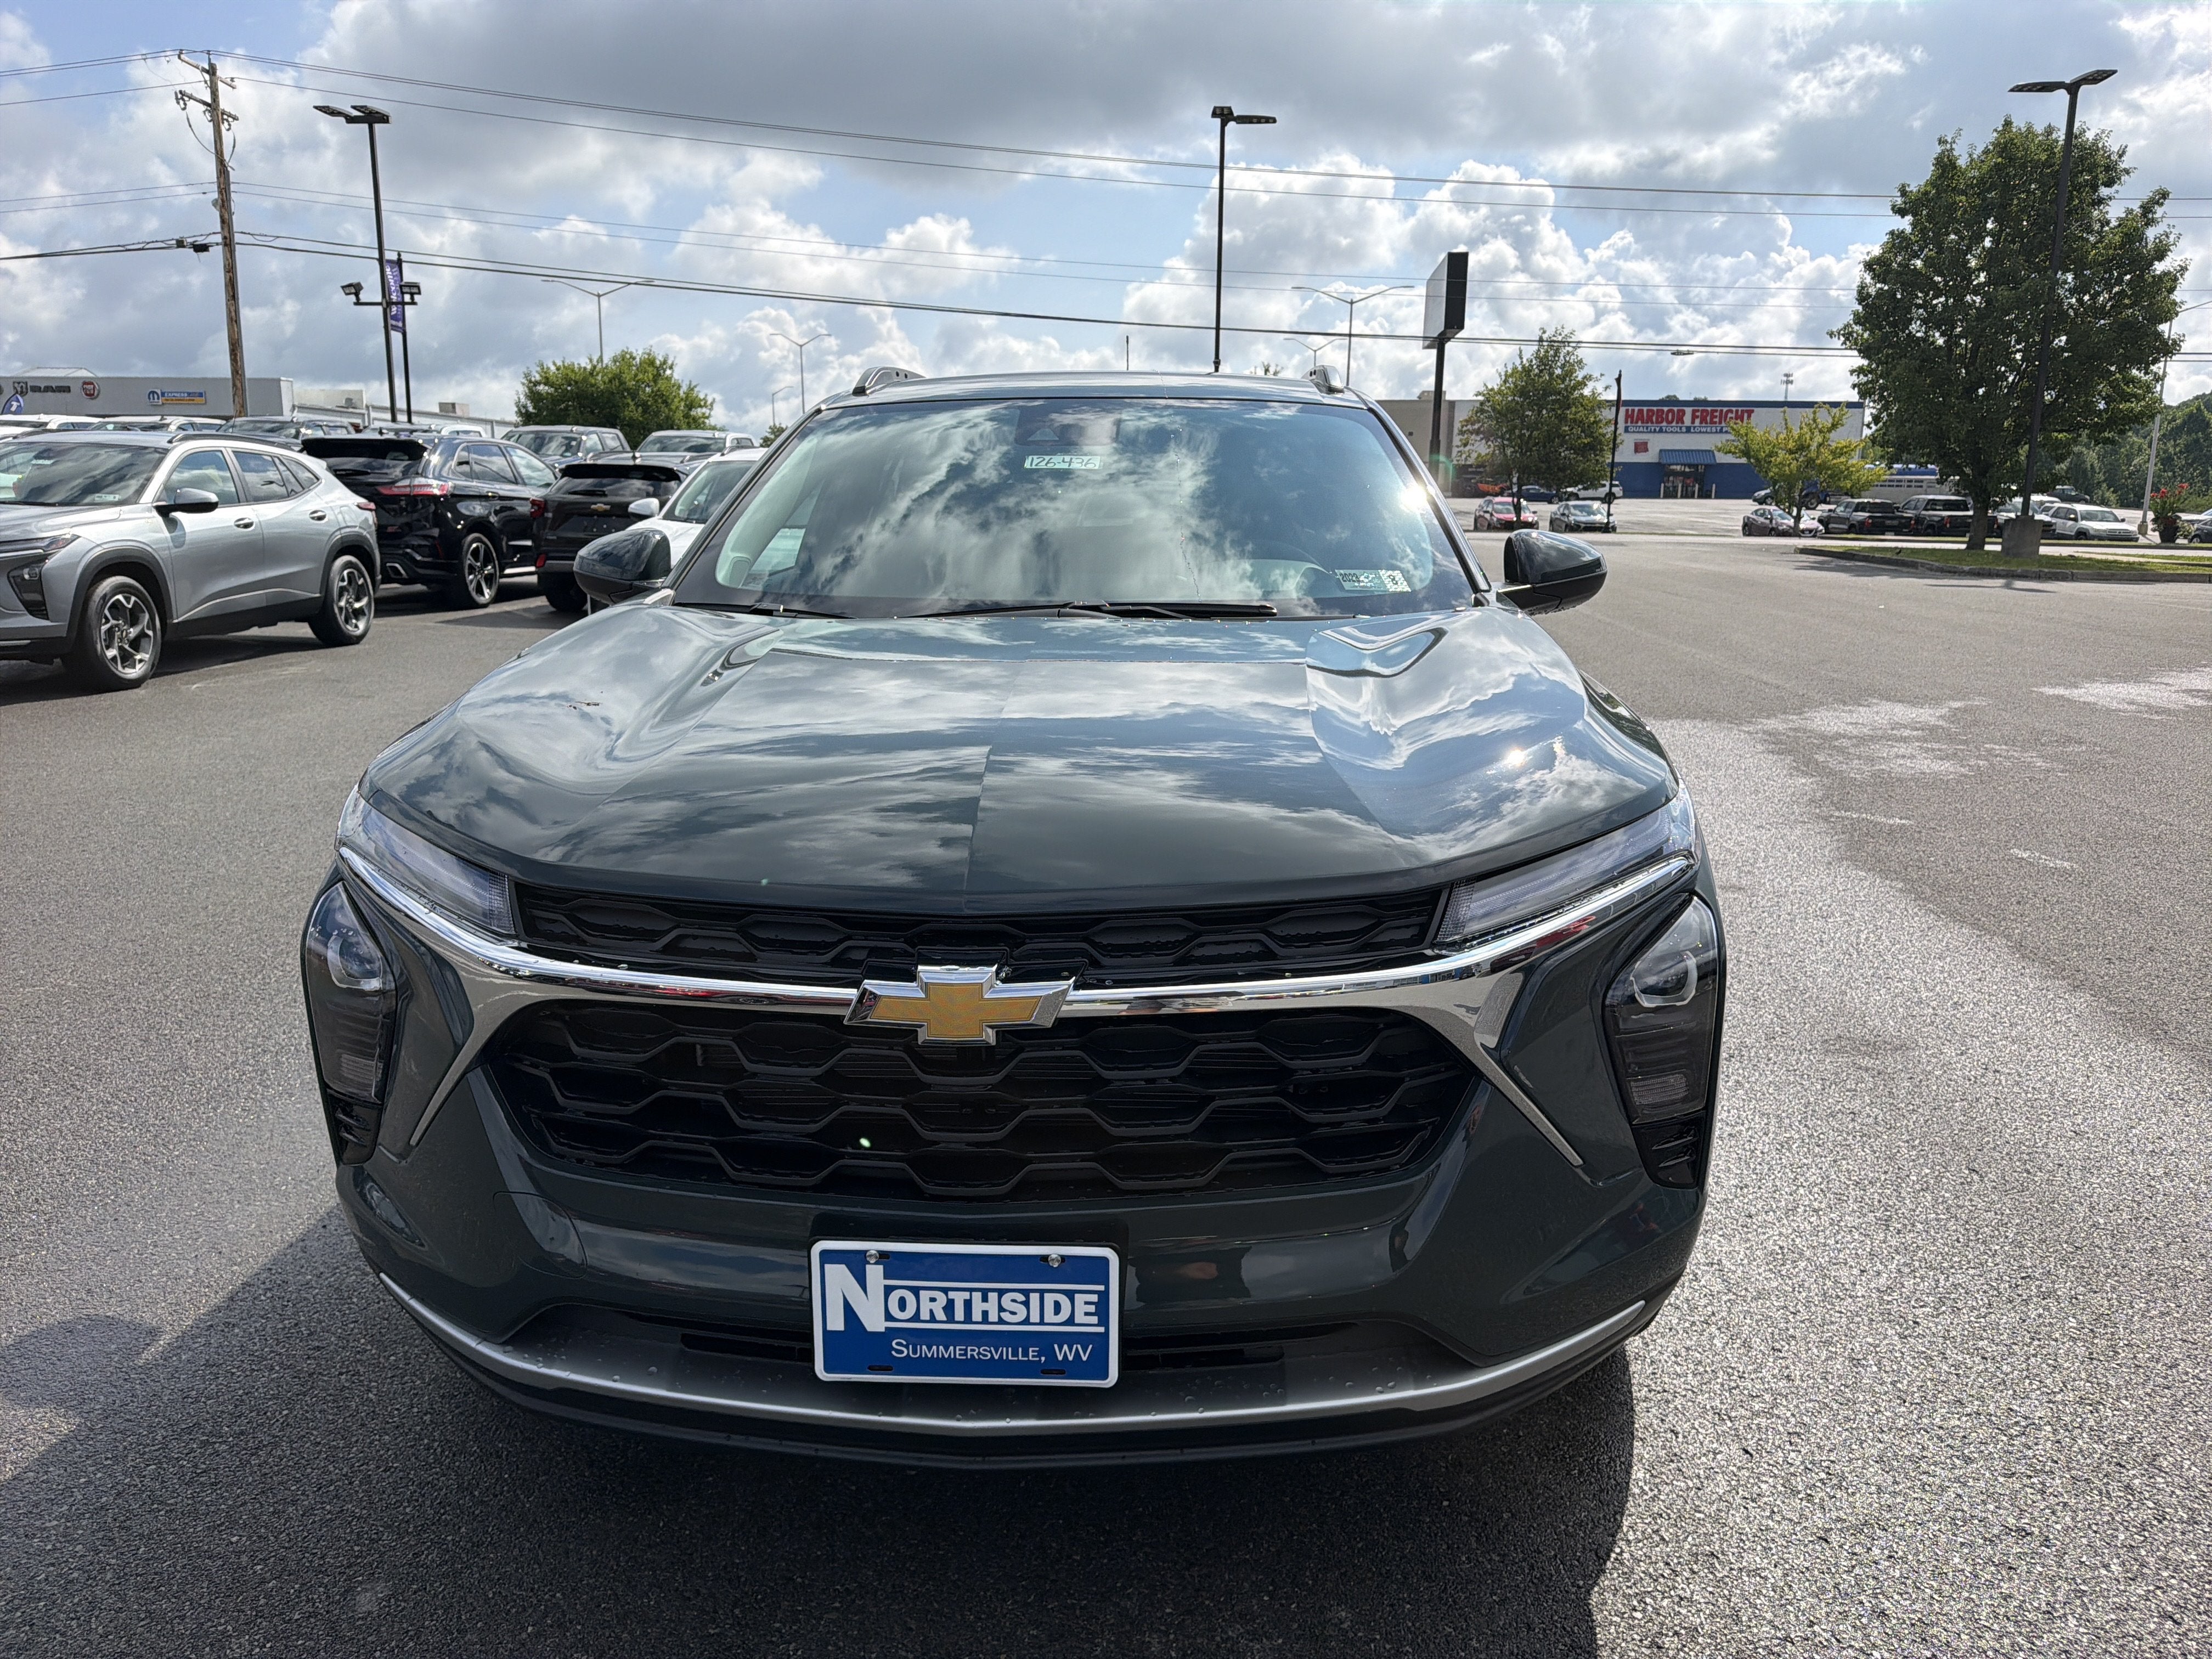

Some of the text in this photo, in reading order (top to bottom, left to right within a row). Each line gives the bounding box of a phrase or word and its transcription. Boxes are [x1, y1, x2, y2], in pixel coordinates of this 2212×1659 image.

[385, 264, 397, 315] Wlcome
[1624, 408, 1754, 425] HARBOR FREIGHT
[1029, 456, 1097, 468] 126-436
[824, 1263, 1099, 1332] NORTHSIDE
[891, 1339, 1093, 1363] SUMMERSVILLE, WV
